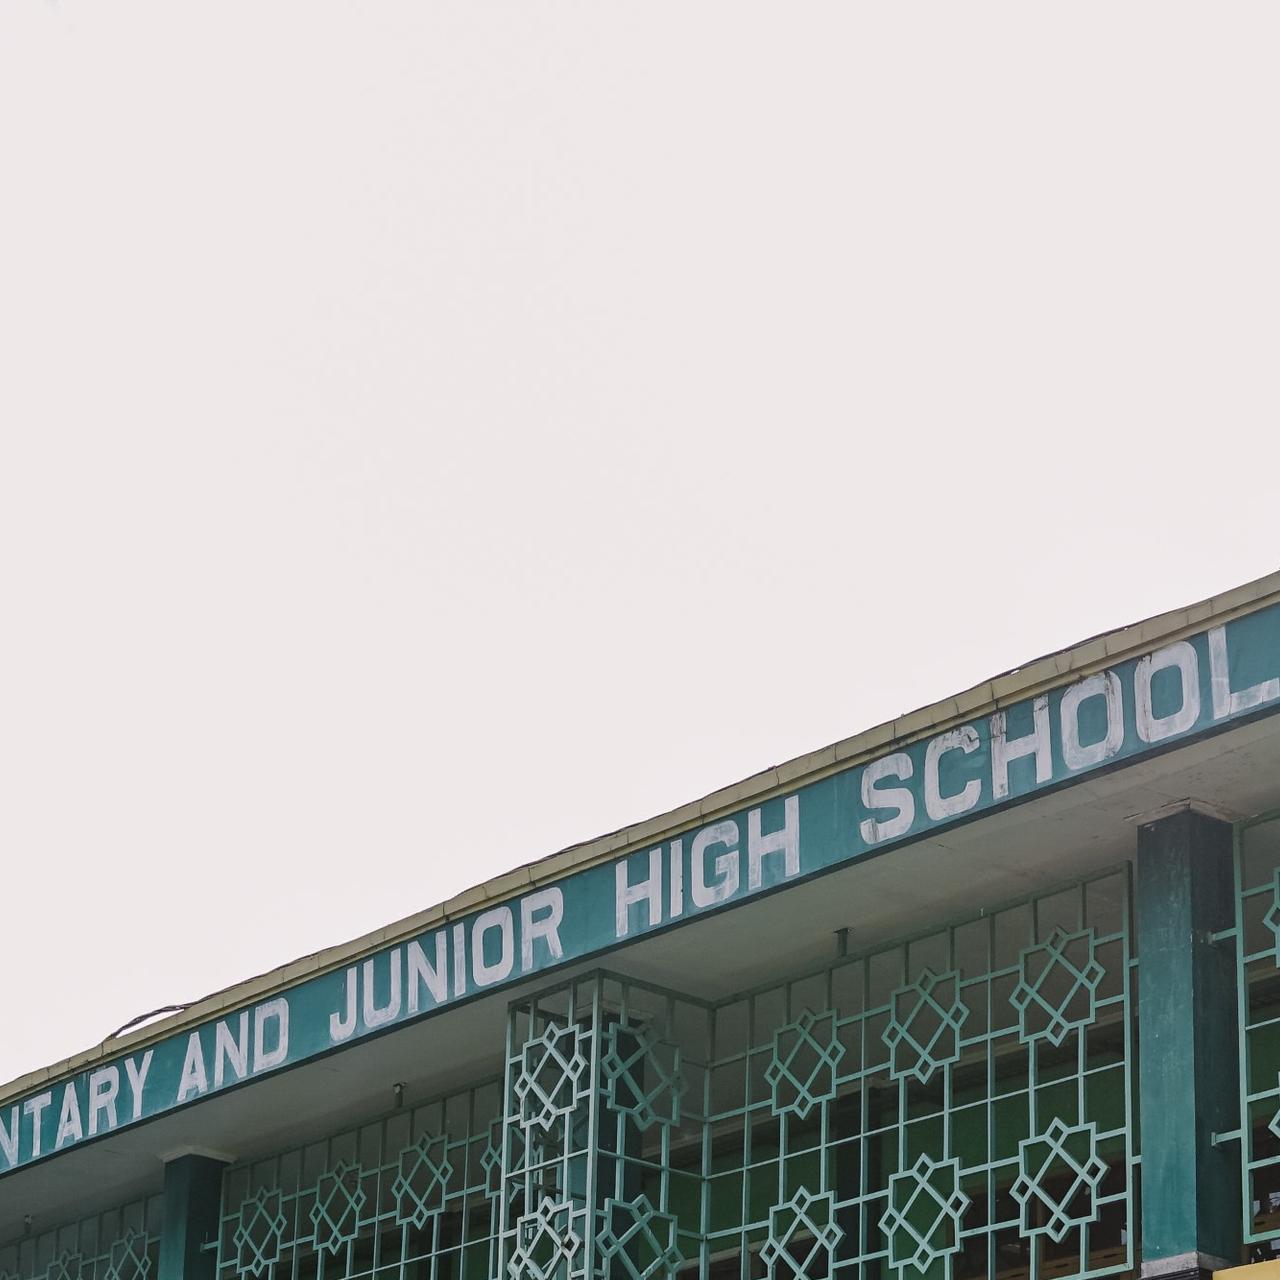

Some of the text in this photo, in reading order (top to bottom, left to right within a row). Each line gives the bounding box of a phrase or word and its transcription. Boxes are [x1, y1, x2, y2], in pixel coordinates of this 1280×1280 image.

[177, 998, 290, 1102] AND
[329, 887, 565, 1041] JUNIOR
[615, 796, 802, 938] HIGH
[860, 625, 1280, 844] SCHOOL
